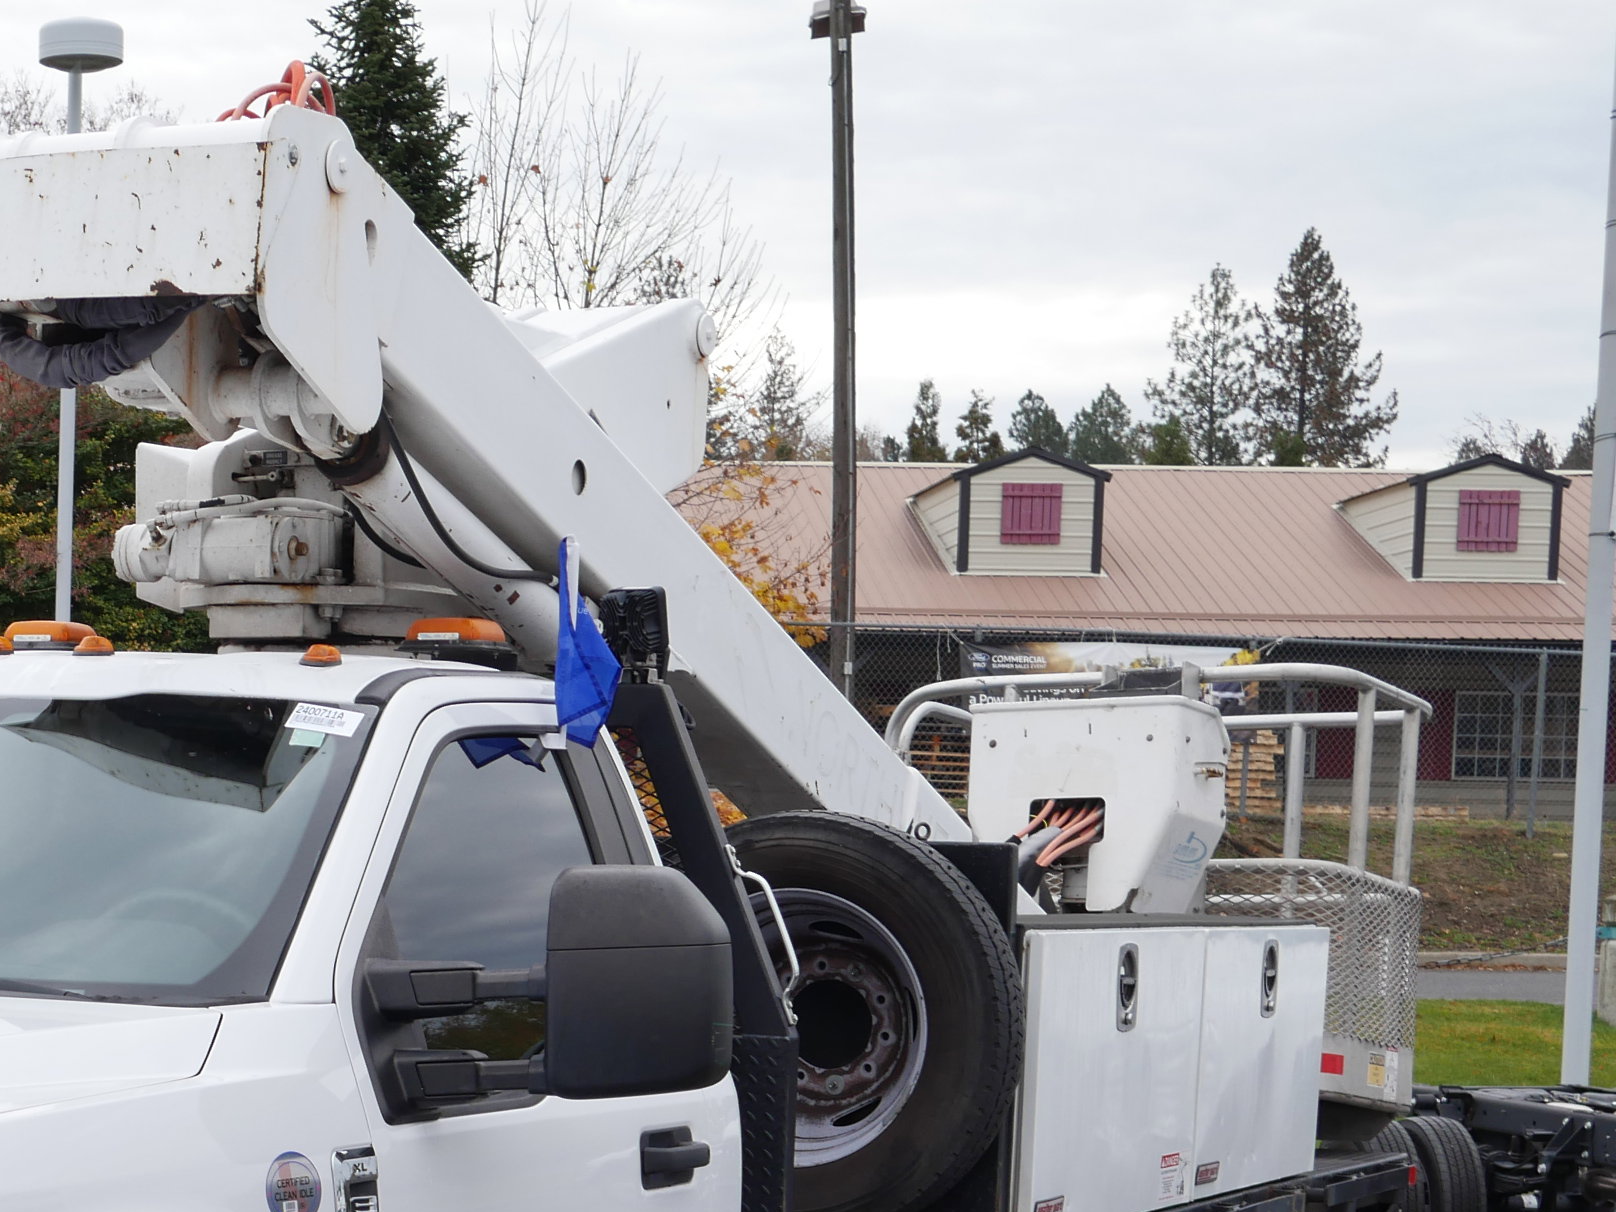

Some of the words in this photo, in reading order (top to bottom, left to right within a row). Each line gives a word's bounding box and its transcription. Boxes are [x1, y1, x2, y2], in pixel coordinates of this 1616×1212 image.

[992, 655, 1046, 663] COMMERCIAL
[295, 705, 344, 720] 2400711A
[353, 1162, 368, 1173] XL
[277, 1175, 310, 1188] CERTIFIED
[275, 1190, 297, 1201] CLEAN
[299, 1187, 314, 1198] IDLE
